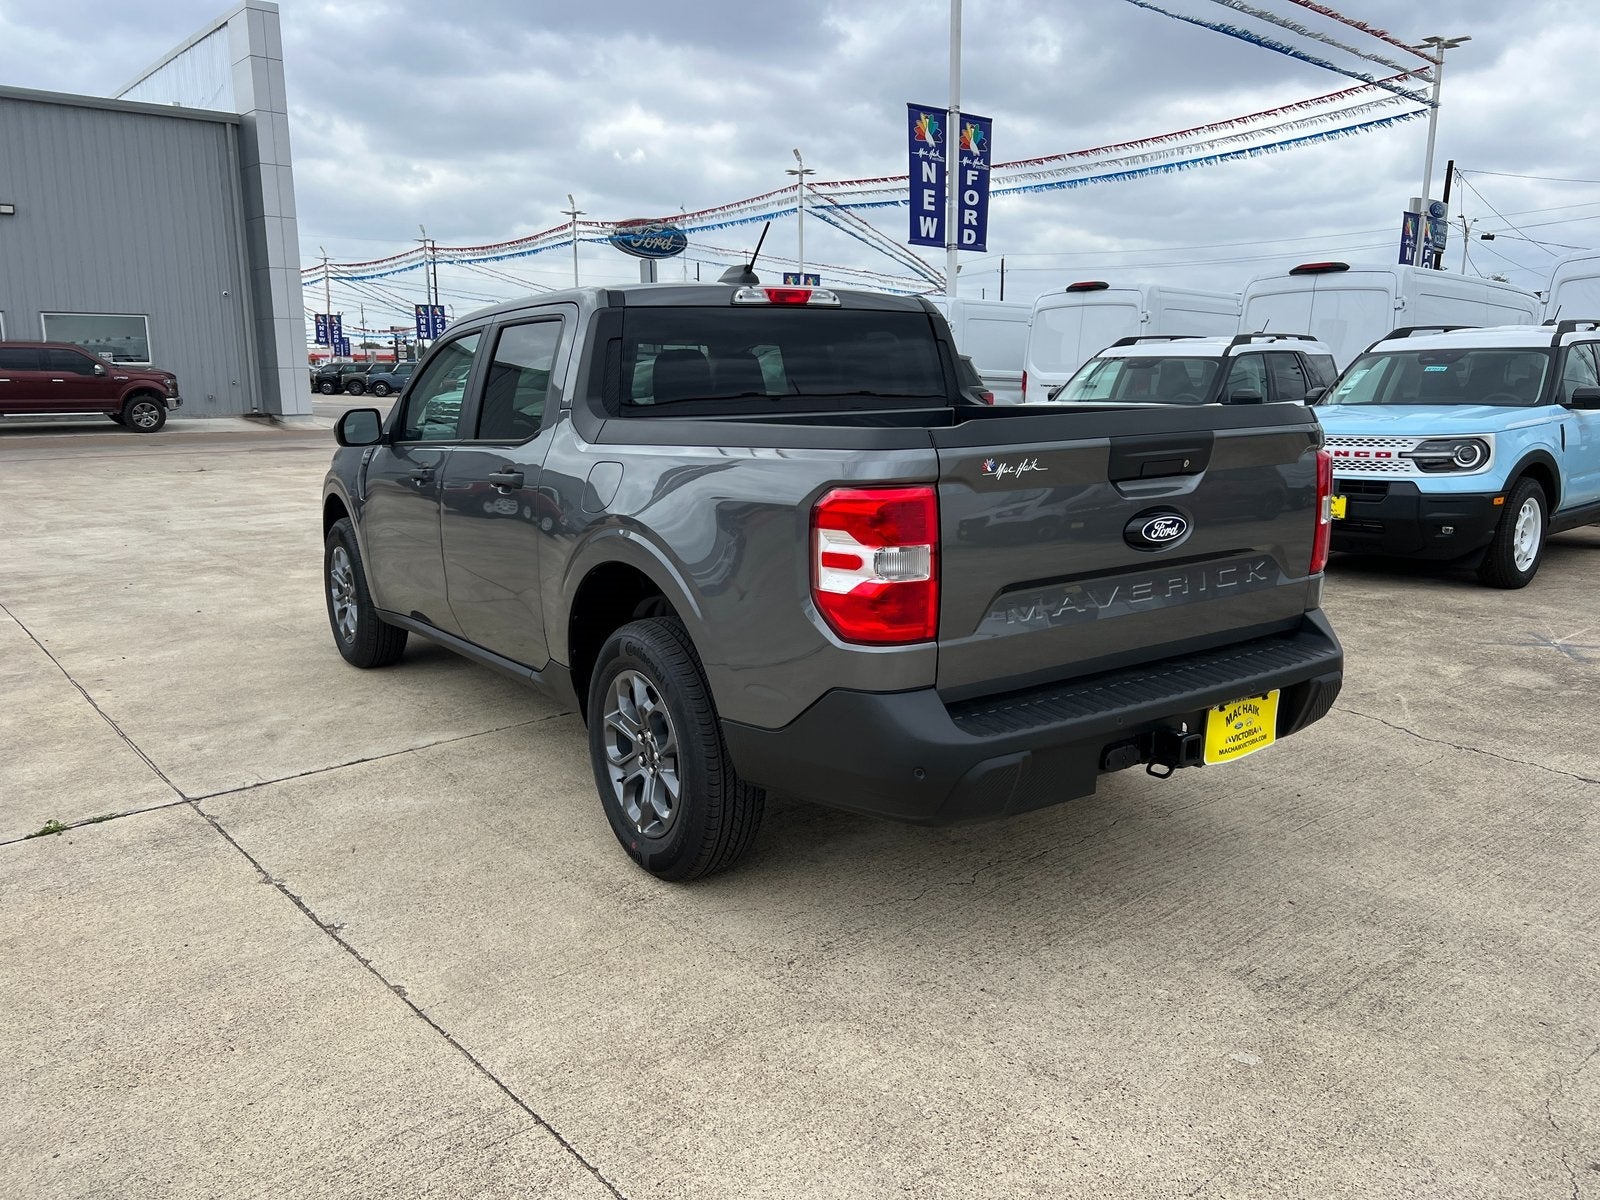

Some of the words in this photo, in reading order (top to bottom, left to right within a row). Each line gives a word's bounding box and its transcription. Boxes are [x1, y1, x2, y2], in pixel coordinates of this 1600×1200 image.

[919, 161, 938, 239] NEW
[962, 170, 980, 245] FORD
[631, 226, 674, 251] Ford
[318, 325, 326, 343] NEW
[419, 318, 428, 338] NEW
[1326, 450, 1392, 459] NCO
[982, 462, 1015, 480] Mac
[1015, 458, 1048, 479] Haik
[1150, 520, 1178, 539] Ford
[1006, 561, 1267, 625] MAVERICK
[1225, 705, 1242, 727] MAC
[1242, 703, 1260, 717] HAIK
[1230, 726, 1258, 743] VICTORIA
